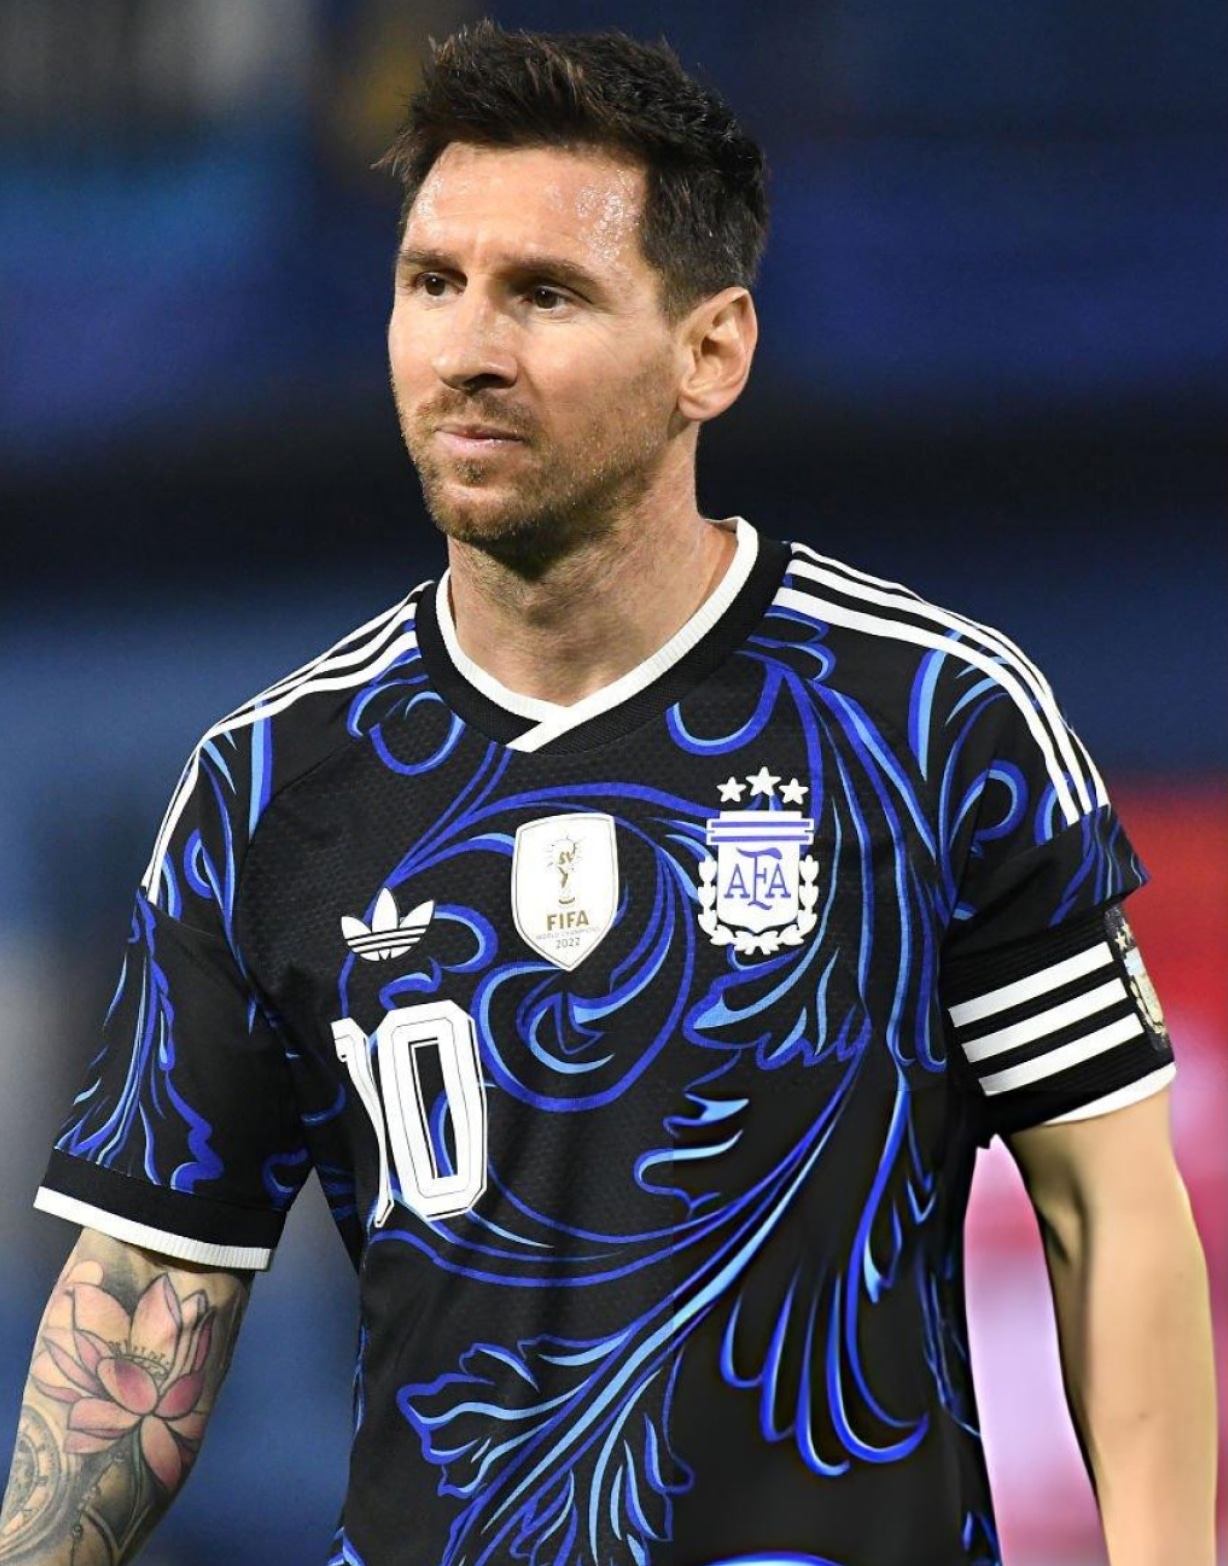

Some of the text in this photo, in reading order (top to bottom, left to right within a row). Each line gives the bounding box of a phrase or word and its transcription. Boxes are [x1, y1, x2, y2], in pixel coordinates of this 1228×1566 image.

[723, 847, 792, 911] AFA
[546, 910, 590, 932] FIFA
[555, 937, 581, 949] 2022
[330, 999, 488, 1228] 10
